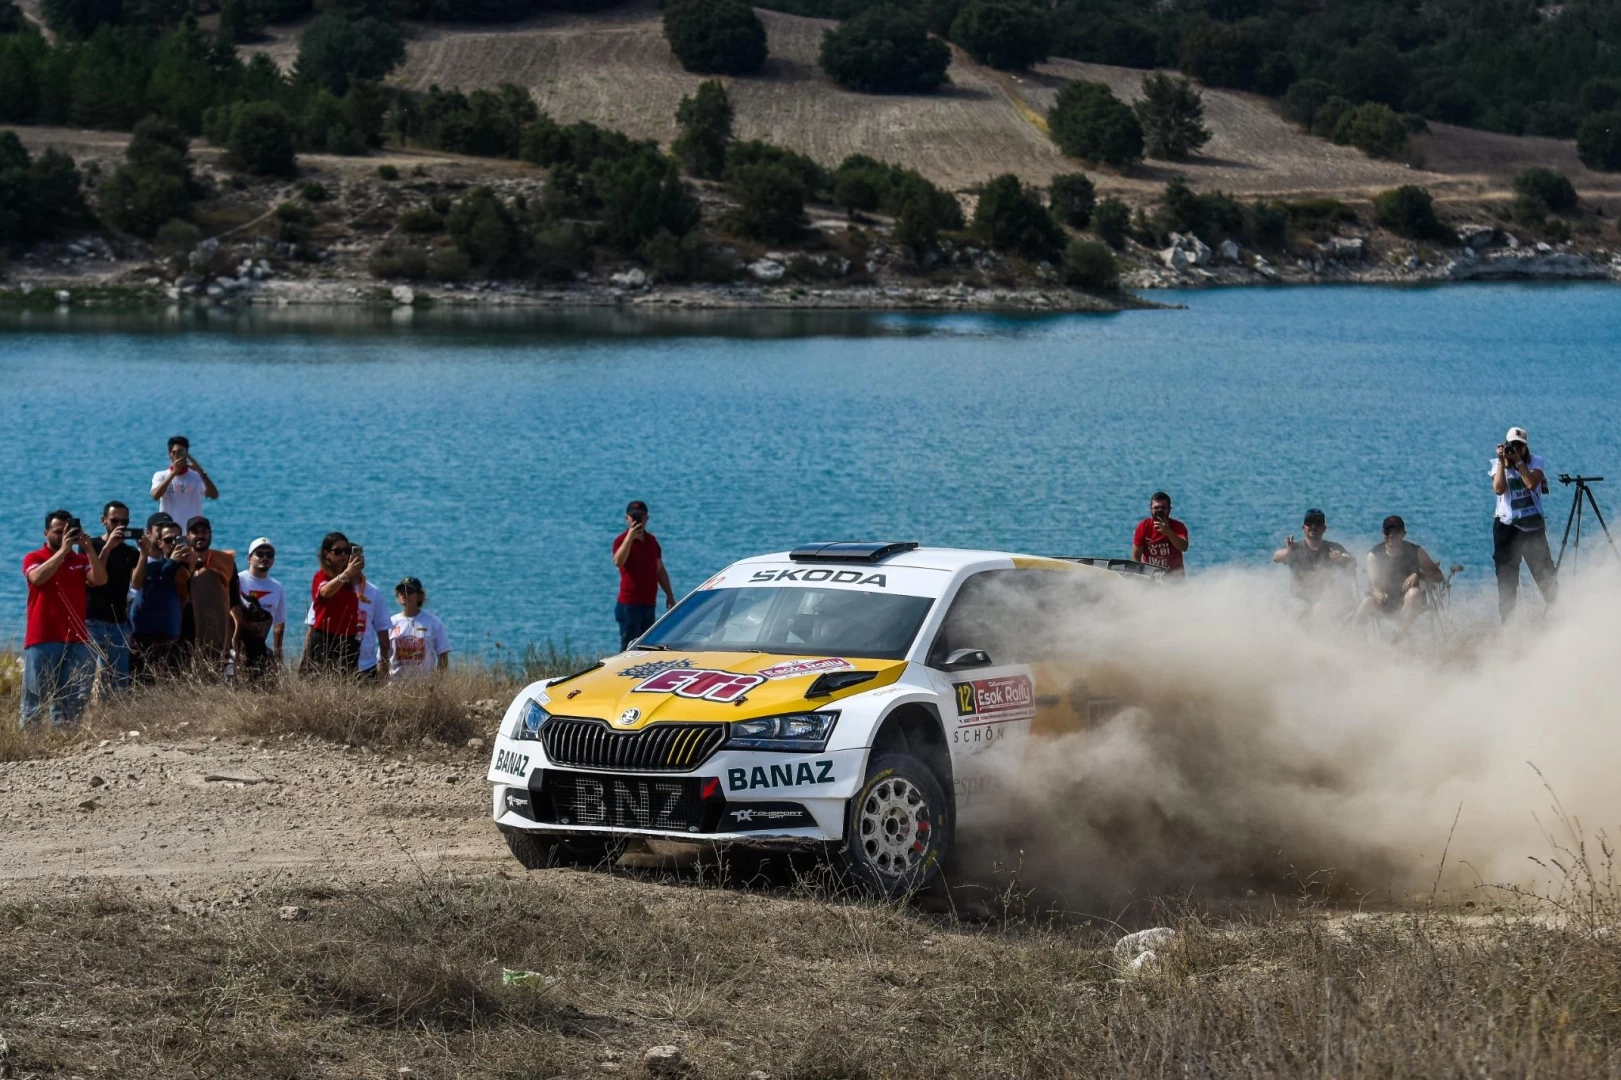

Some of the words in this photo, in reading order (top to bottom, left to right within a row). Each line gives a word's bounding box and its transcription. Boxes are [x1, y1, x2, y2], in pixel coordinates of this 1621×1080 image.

[958, 685, 973, 712] 12
[977, 687, 1004, 706] Esok
[1005, 683, 1031, 704] Rally
[954, 726, 1004, 743] SCHÖN
[495, 749, 529, 777] BANAZ
[728, 760, 835, 791] BANAZ
[575, 777, 687, 829] BNZ
